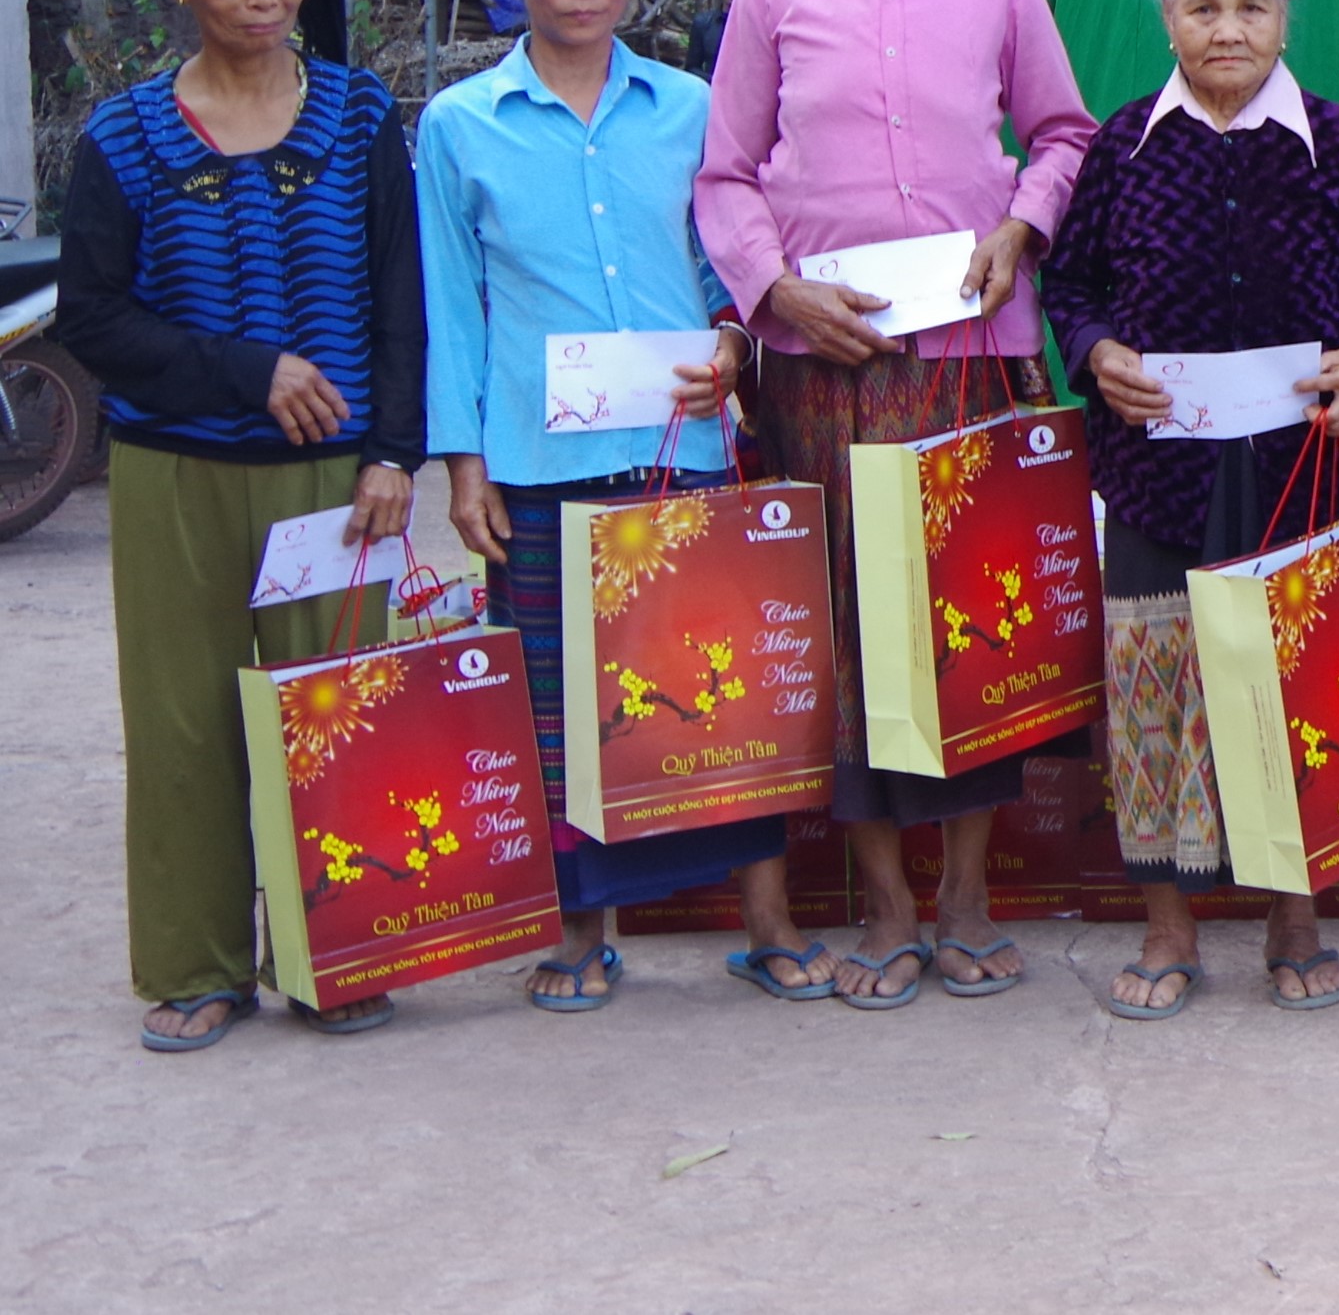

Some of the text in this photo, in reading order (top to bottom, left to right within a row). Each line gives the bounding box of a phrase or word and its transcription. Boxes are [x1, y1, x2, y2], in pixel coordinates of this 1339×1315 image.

[1036, 523, 1077, 546] Chúc
[760, 599, 810, 623] Chúc
[981, 662, 1061, 705] Quỹ Thiện Tâm
[465, 749, 517, 773] Chúc
[661, 740, 777, 777] Quỹ Thiện Tâm
[372, 892, 494, 935] Quỹ Thiện Tâm
